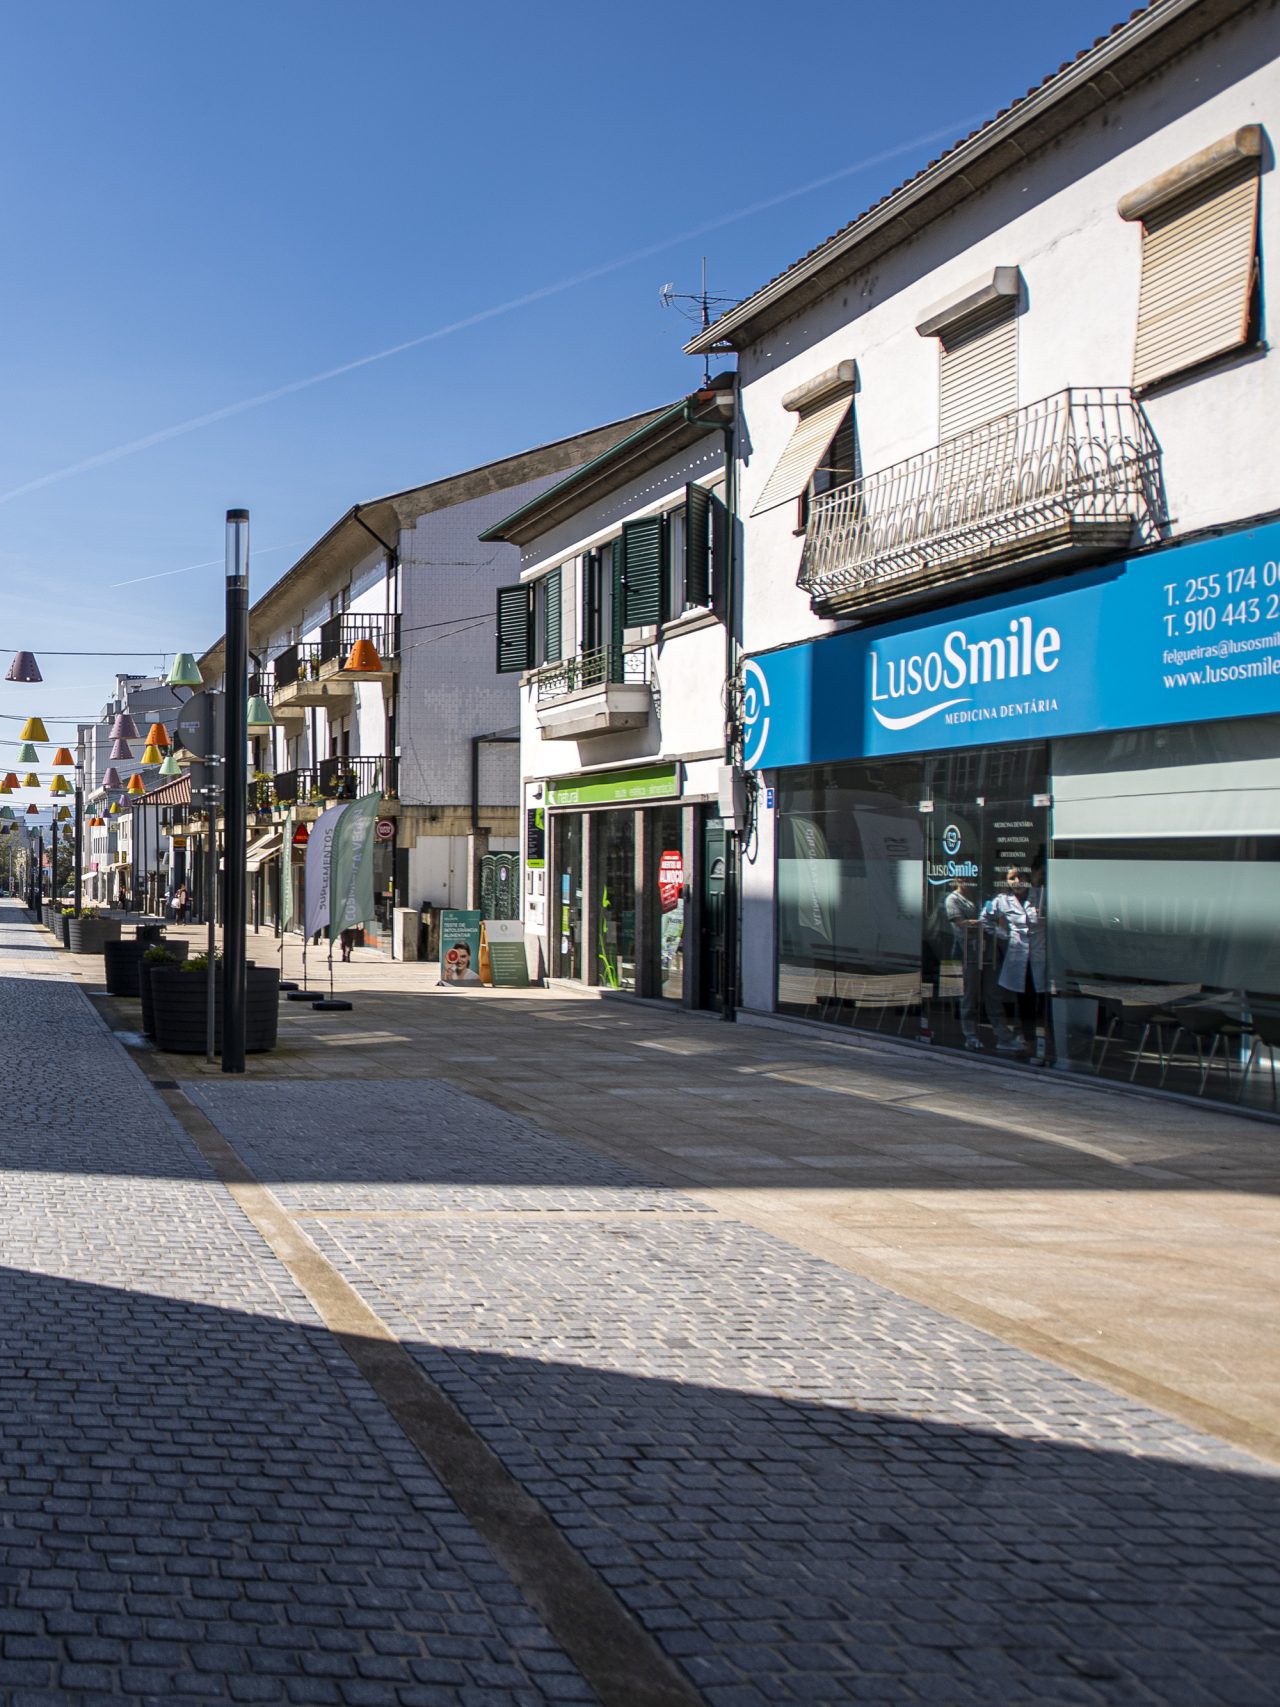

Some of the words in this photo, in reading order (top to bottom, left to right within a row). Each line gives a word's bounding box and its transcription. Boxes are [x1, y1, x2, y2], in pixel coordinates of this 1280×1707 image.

[1163, 583, 1180, 606] T.
[1185, 573, 1221, 603] 255
[1226, 565, 1257, 594] 174
[1263, 561, 1280, 587] 0
[1163, 614, 1179, 637] T.
[1184, 606, 1217, 634] 910
[1221, 598, 1261, 626] 443
[870, 616, 1061, 700] LusoSmile
[945, 708, 998, 725] MEDICINA
[1000, 698, 1059, 717] DENTÁRIA
[320, 828, 333, 910] SUPLEMENTOS
[928, 860, 979, 878] LusoSmile
